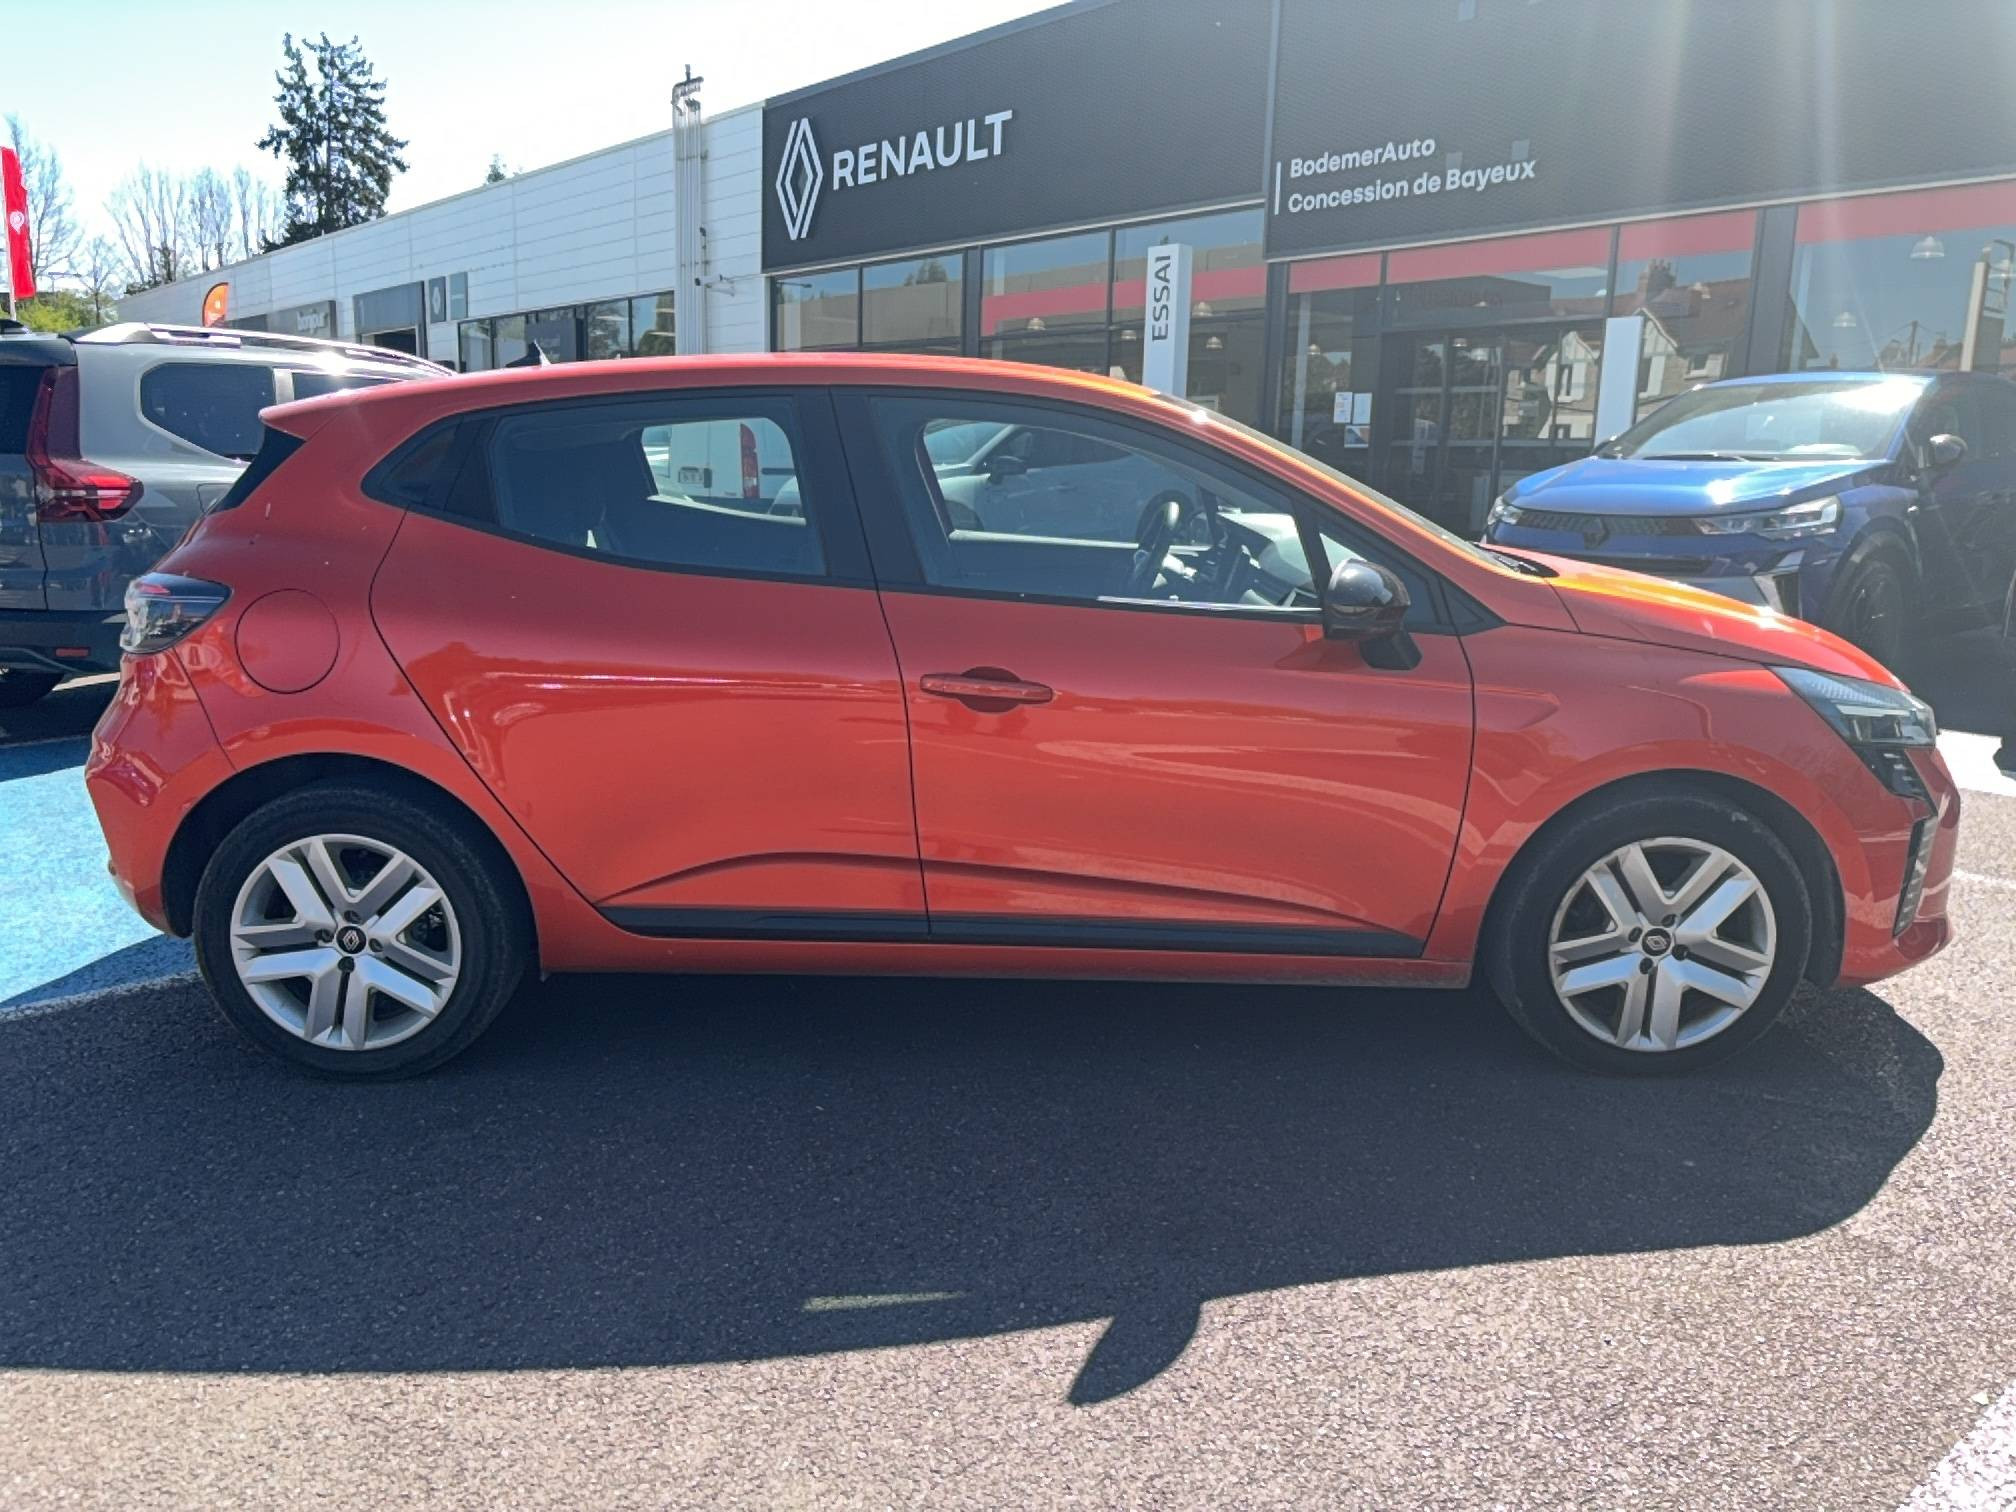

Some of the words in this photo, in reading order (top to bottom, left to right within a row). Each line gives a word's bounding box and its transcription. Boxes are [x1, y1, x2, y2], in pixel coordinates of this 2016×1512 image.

[833, 109, 1013, 191] RENAULT
[1290, 138, 1436, 178] BodemerAuto
[1288, 179, 1409, 213] Concession
[1413, 172, 1441, 195] de
[1445, 160, 1536, 192] Bayeux
[1152, 255, 1171, 342] ESSAI
